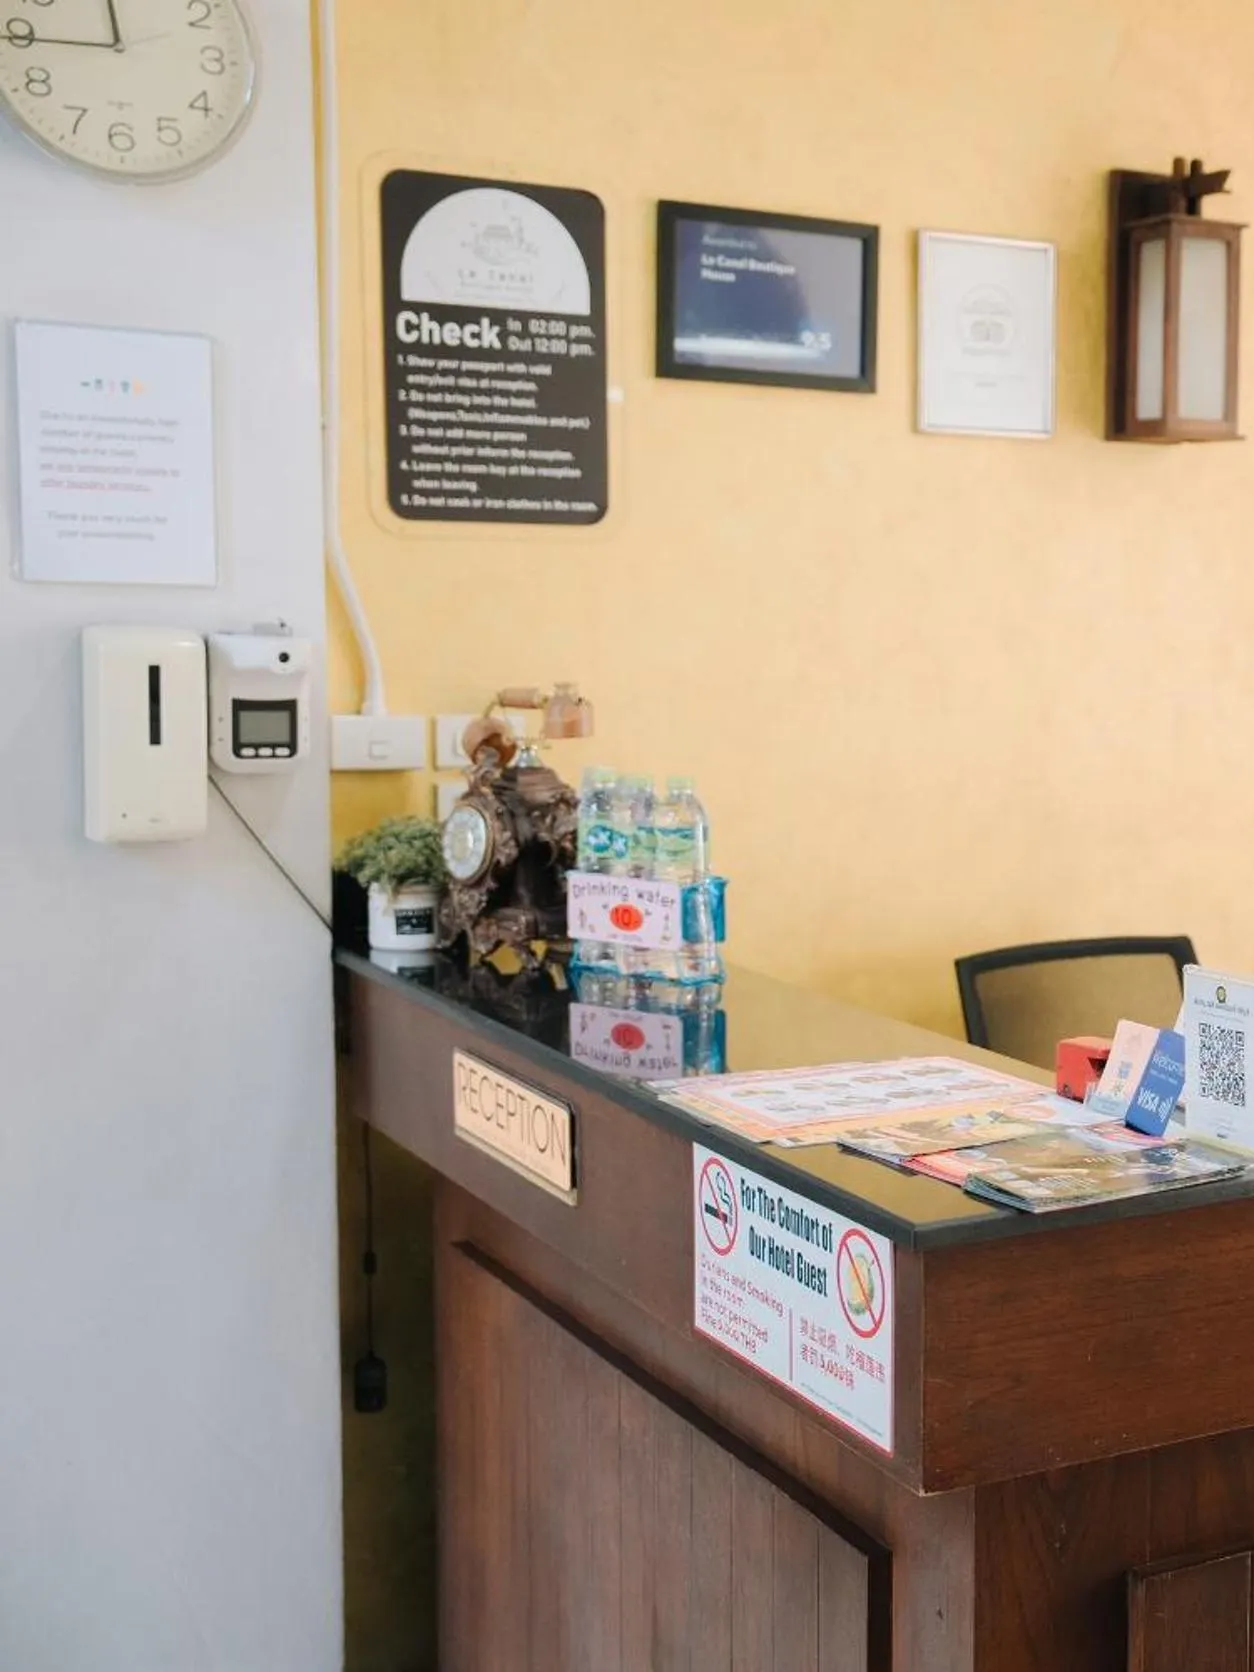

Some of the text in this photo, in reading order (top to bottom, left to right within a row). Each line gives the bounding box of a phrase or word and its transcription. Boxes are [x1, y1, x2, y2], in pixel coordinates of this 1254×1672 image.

[187, 0, 212, 29] 2
[6, 17, 34, 48] 9
[200, 45, 226, 76] 3
[25, 66, 52, 97] 8
[188, 90, 213, 118] 4
[63, 104, 88, 135] 7
[156, 117, 182, 147] 5
[108, 122, 135, 152] 6
[396, 310, 502, 350] Check
[507, 317, 522, 332] In
[528, 319, 567, 336] 02:00
[507, 336, 532, 351] Out
[534, 338, 567, 354] 12:00
[437, 359, 459, 370] your
[460, 360, 504, 373] passport
[506, 362, 527, 373] with
[427, 391, 443, 402] not
[444, 392, 471, 406] bring
[493, 395, 509, 407] the
[426, 427, 444, 437] not
[511, 447, 526, 459] the
[444, 462, 460, 473] the
[520, 464, 536, 476] the
[429, 496, 445, 506] not
[553, 499, 569, 510] the
[572, 882, 676, 908] Drinking water
[458, 1061, 566, 1166] RECEPTION
[1138, 1087, 1160, 1113] VISA
[740, 1178, 834, 1254] For The Comfort of
[749, 1226, 828, 1297] Our Hotel Guest
